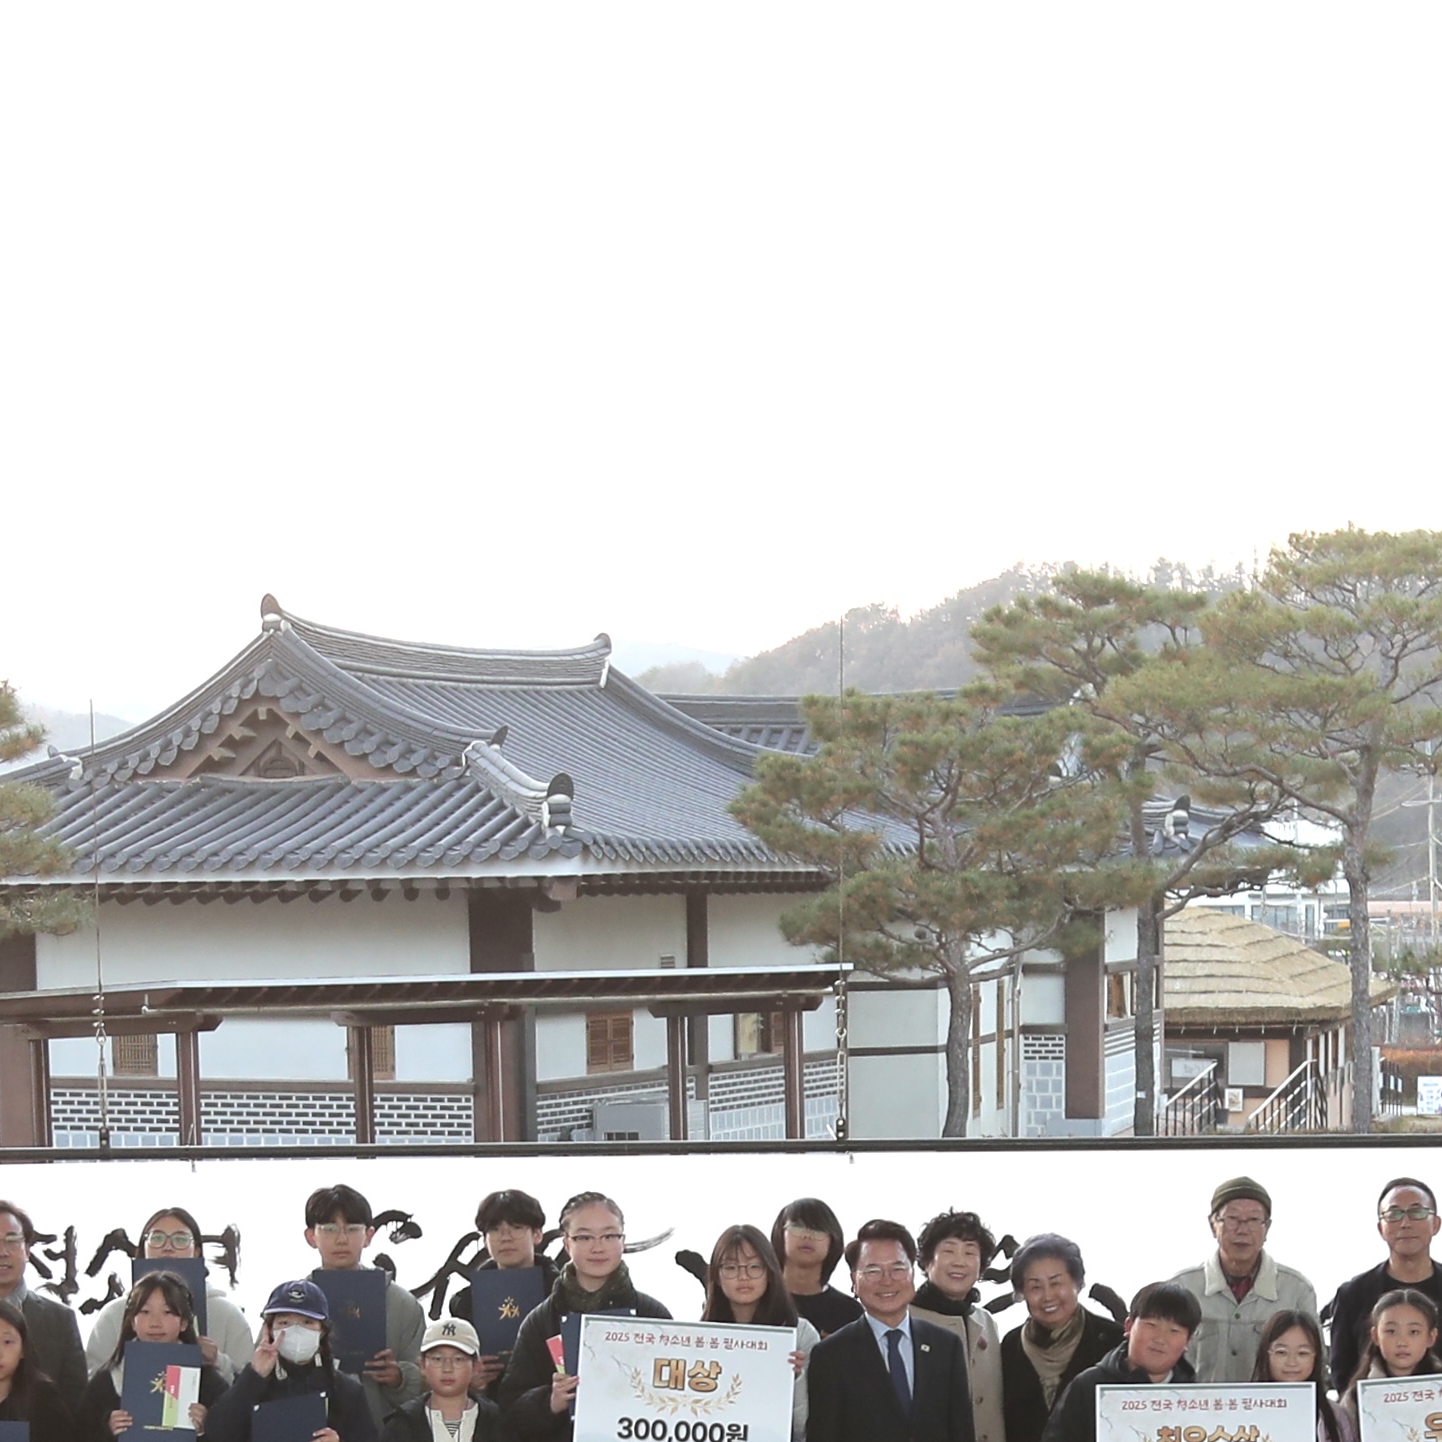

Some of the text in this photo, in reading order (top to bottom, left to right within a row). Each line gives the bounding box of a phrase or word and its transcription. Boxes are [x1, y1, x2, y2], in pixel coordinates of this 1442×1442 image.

[605, 1331, 630, 1342] 2025
[634, 1333, 656, 1345] 전국
[659, 1333, 691, 1348] 청소년
[723, 1337, 768, 1351] 필사대회
[652, 1357, 723, 1393] 대상
[1121, 1399, 1147, 1411] 2025
[1151, 1399, 1173, 1411] 전국
[1177, 1399, 1210, 1411] 청소년
[1242, 1398, 1287, 1411] 필사대회
[1383, 1392, 1409, 1403] 2025
[1412, 1390, 1435, 1402] 전국
